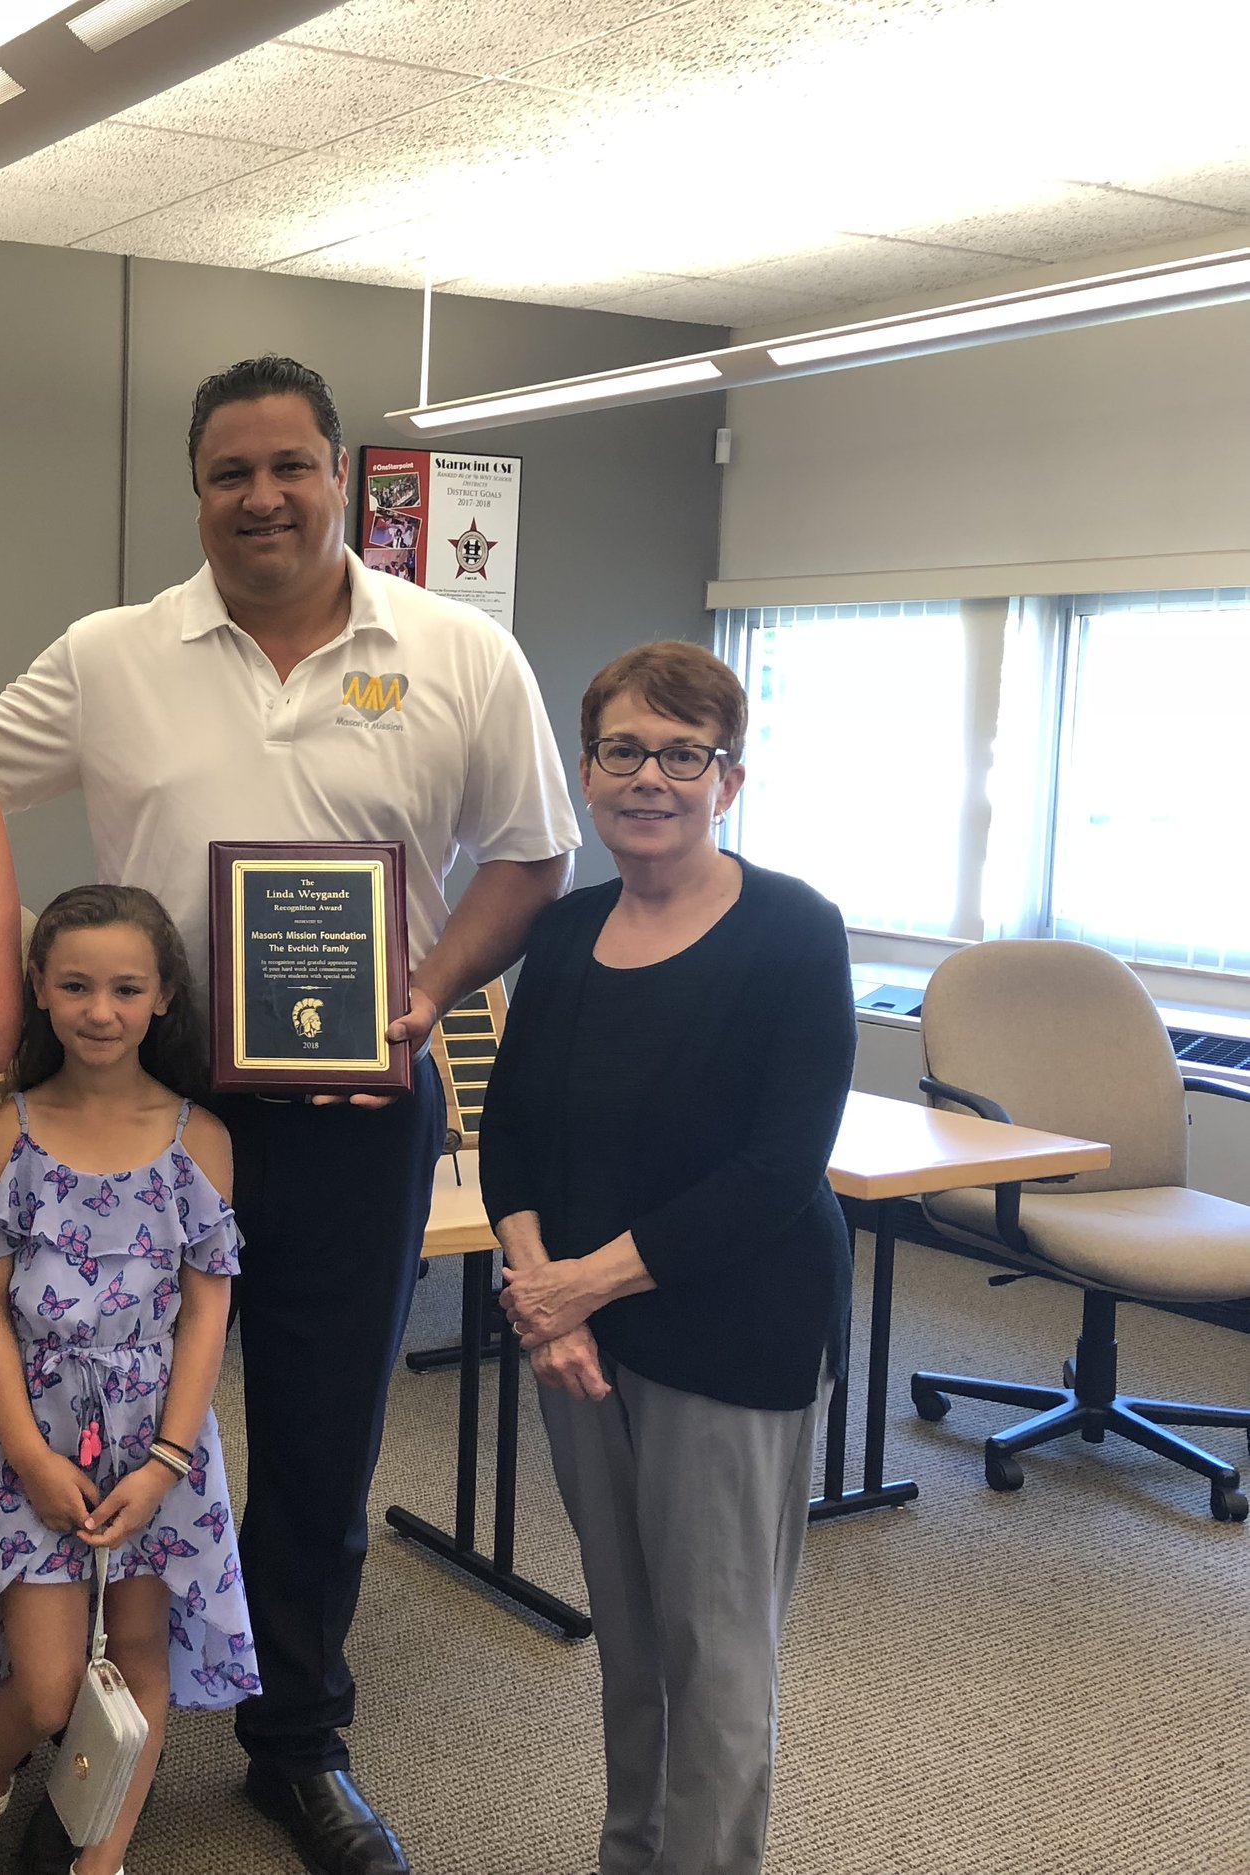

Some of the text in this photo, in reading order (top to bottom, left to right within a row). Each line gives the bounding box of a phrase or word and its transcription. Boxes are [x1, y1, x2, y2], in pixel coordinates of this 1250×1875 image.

[435, 458, 514, 474] Starpoint CSD
[447, 487, 502, 499] DISTRICT GOALS
[457, 498, 491, 508] 2017-2018
[335, 716, 404, 732] Mason's Mission
[266, 889, 350, 901] Linda Weygandt
[273, 904, 317, 913] Recognition
[251, 931, 367, 940] Mason's Mission Foundation
[269, 944, 350, 954] The Evchich Family
[302, 1041, 320, 1049] 2018
